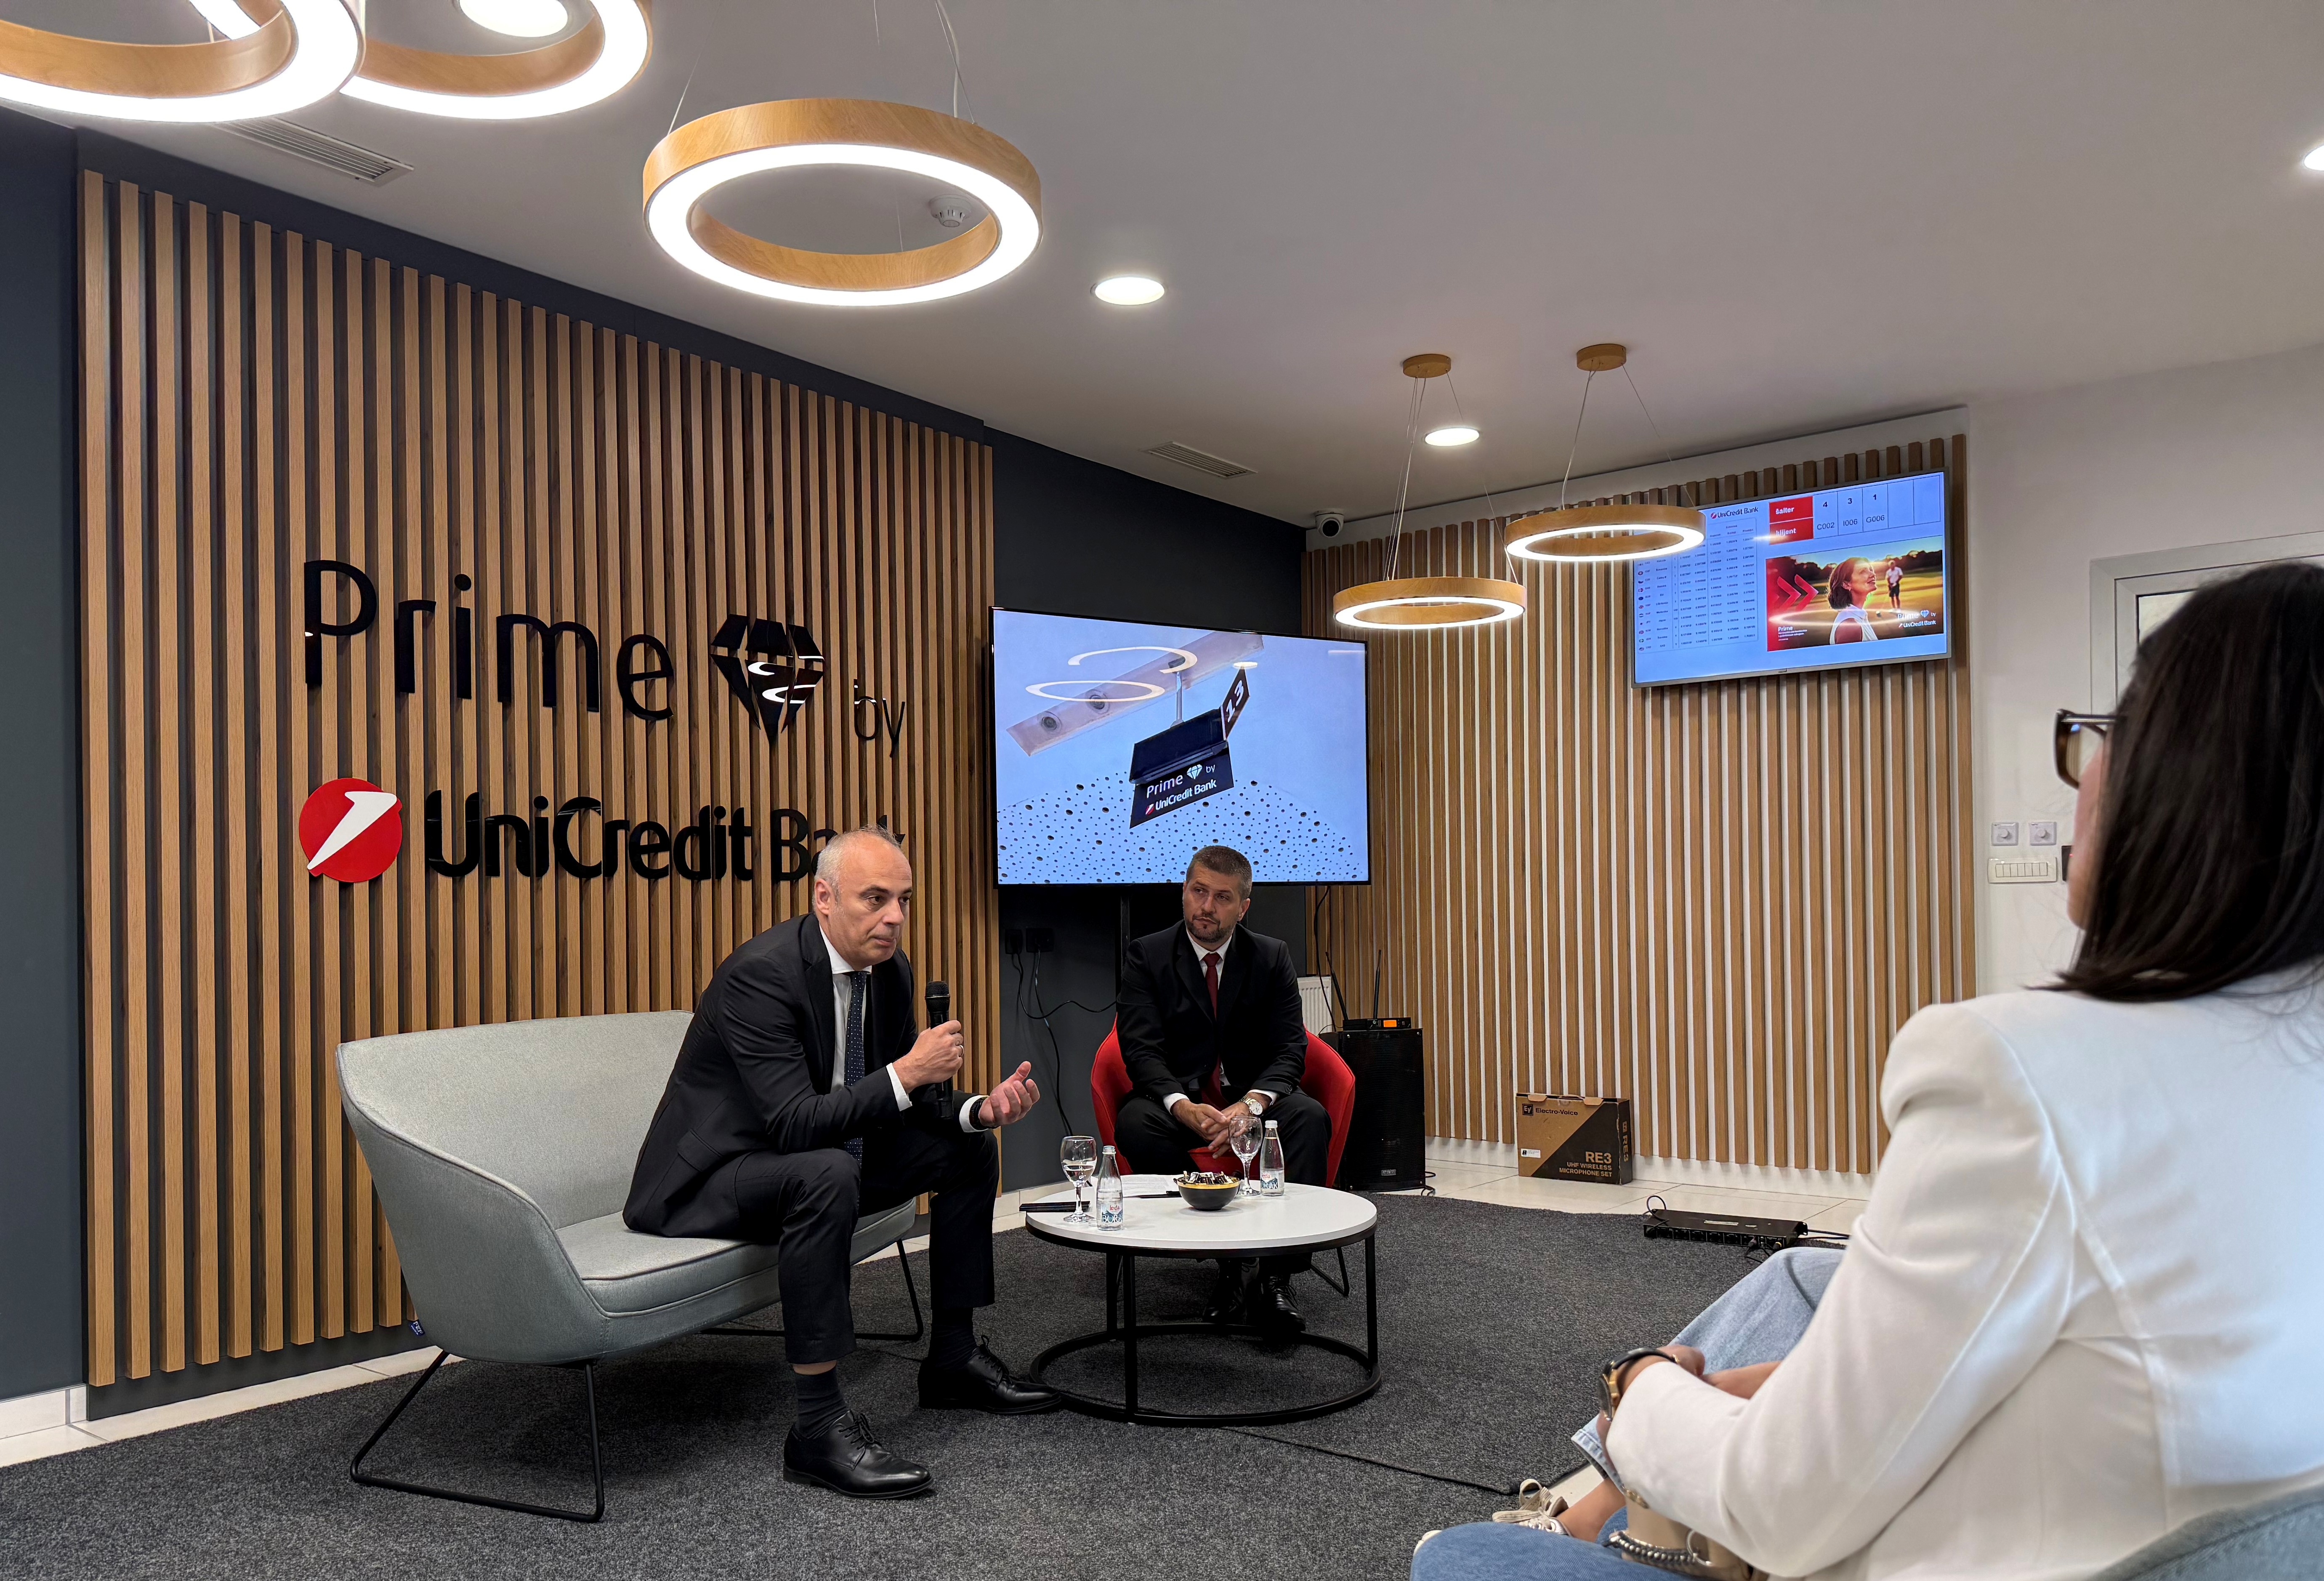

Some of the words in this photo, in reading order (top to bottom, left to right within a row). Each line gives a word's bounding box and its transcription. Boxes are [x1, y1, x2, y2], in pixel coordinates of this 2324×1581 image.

[1718, 509, 1742, 518] UniCredit
[1866, 515, 1885, 523] G006
[304, 560, 674, 721] Prime
[854, 679, 905, 758] by
[1146, 775, 1183, 798] Prime
[1206, 764, 1216, 774] by
[1155, 788, 1193, 810] UniCredit
[1194, 779, 1217, 795] Bank
[425, 790, 753, 881] UniCredit
[1585, 1151, 1612, 1164] RE3
[1559, 1168, 1599, 1176] MICROPHONE
